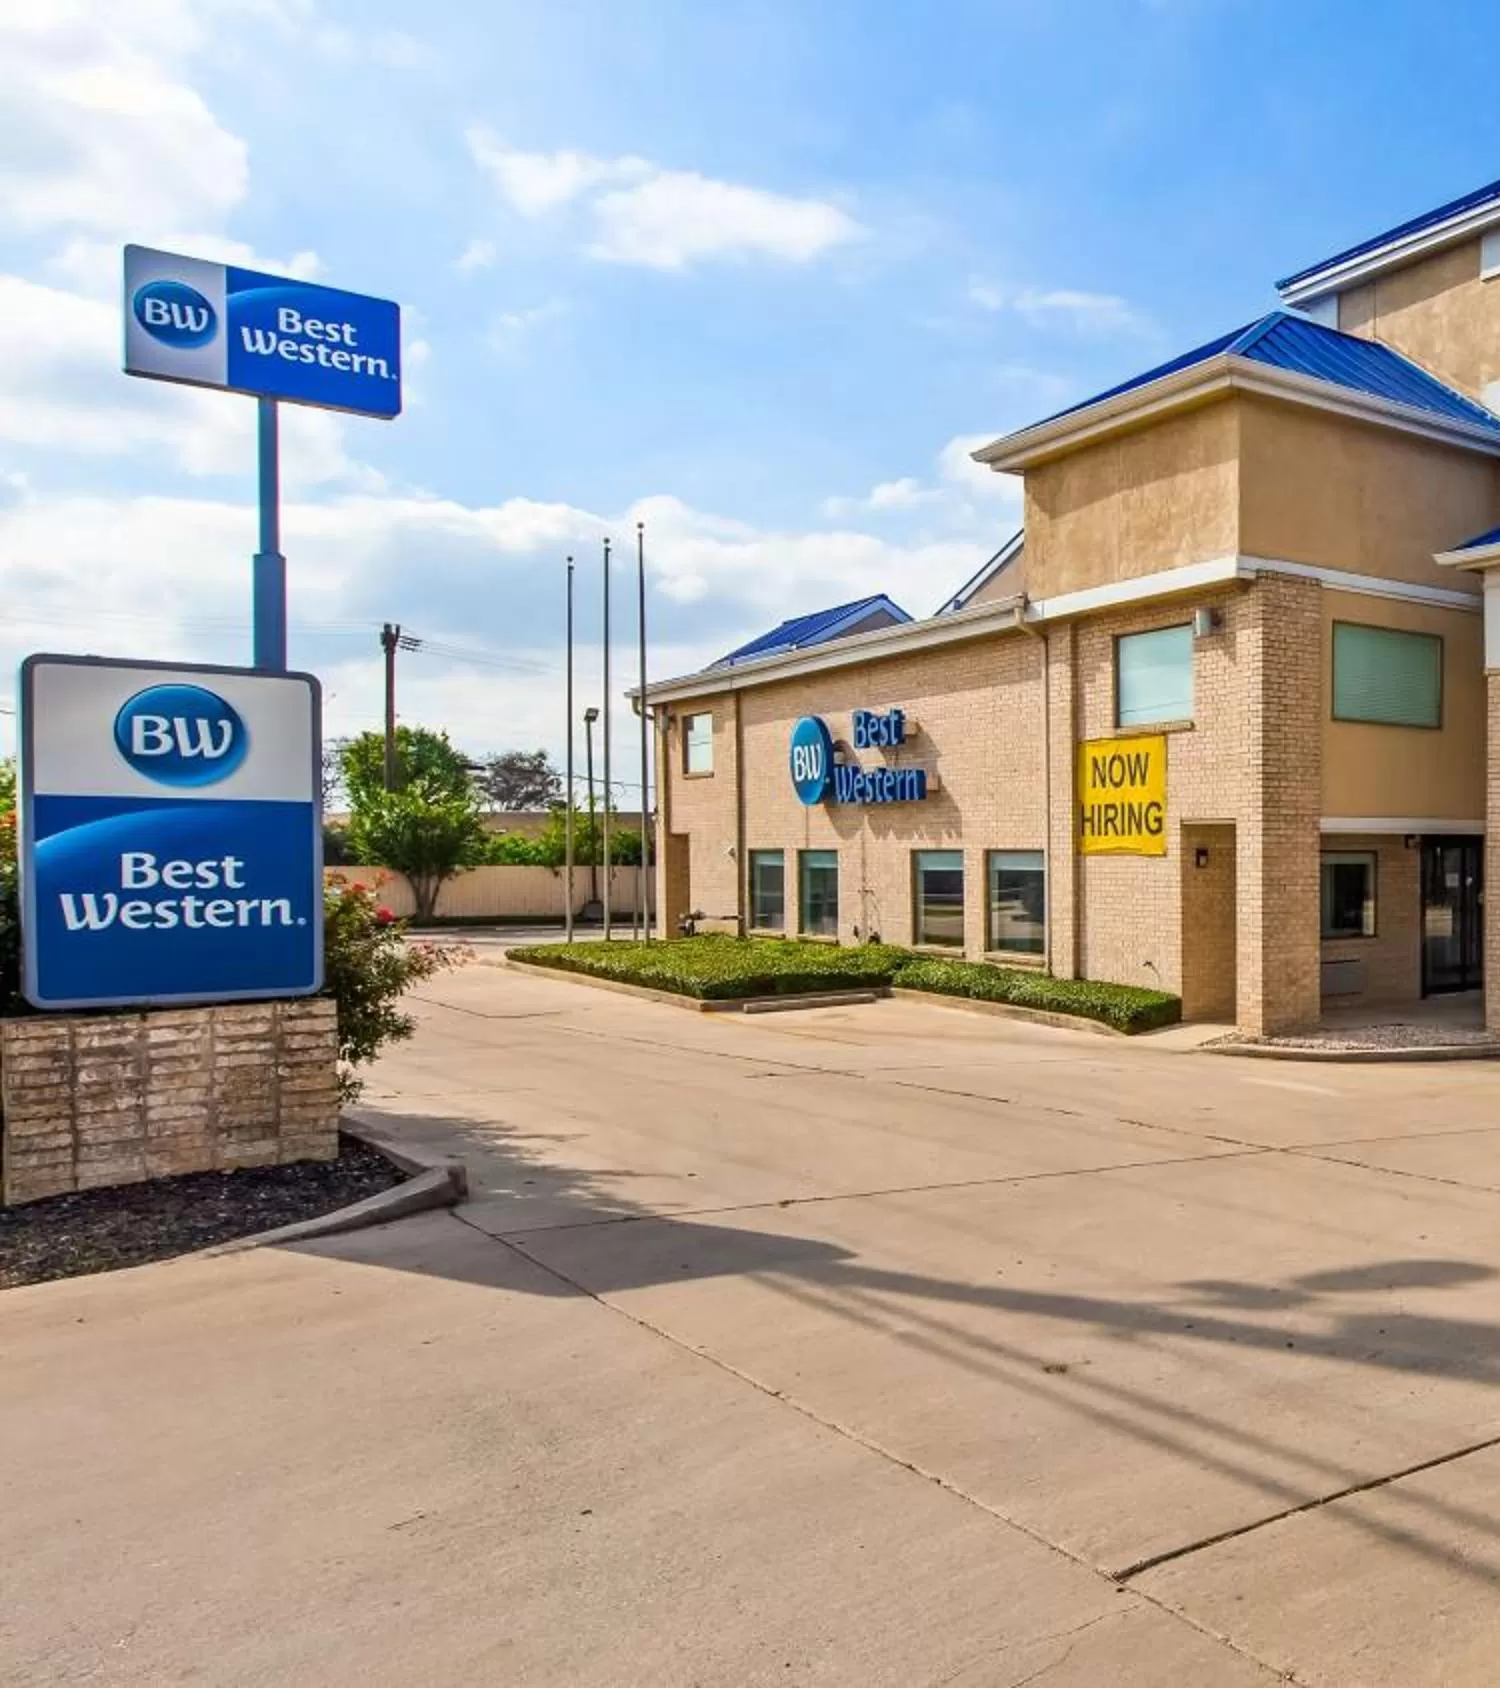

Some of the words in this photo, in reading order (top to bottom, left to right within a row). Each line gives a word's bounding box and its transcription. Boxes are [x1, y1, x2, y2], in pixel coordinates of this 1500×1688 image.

[144, 297, 209, 332] BW
[277, 307, 358, 347] Best
[132, 715, 233, 759] BW
[852, 708, 902, 748] Best
[793, 744, 822, 782] BW
[1091, 752, 1149, 789] NOW
[834, 765, 921, 803] Western
[1081, 801, 1163, 836] HIRING
[120, 852, 246, 889] Best
